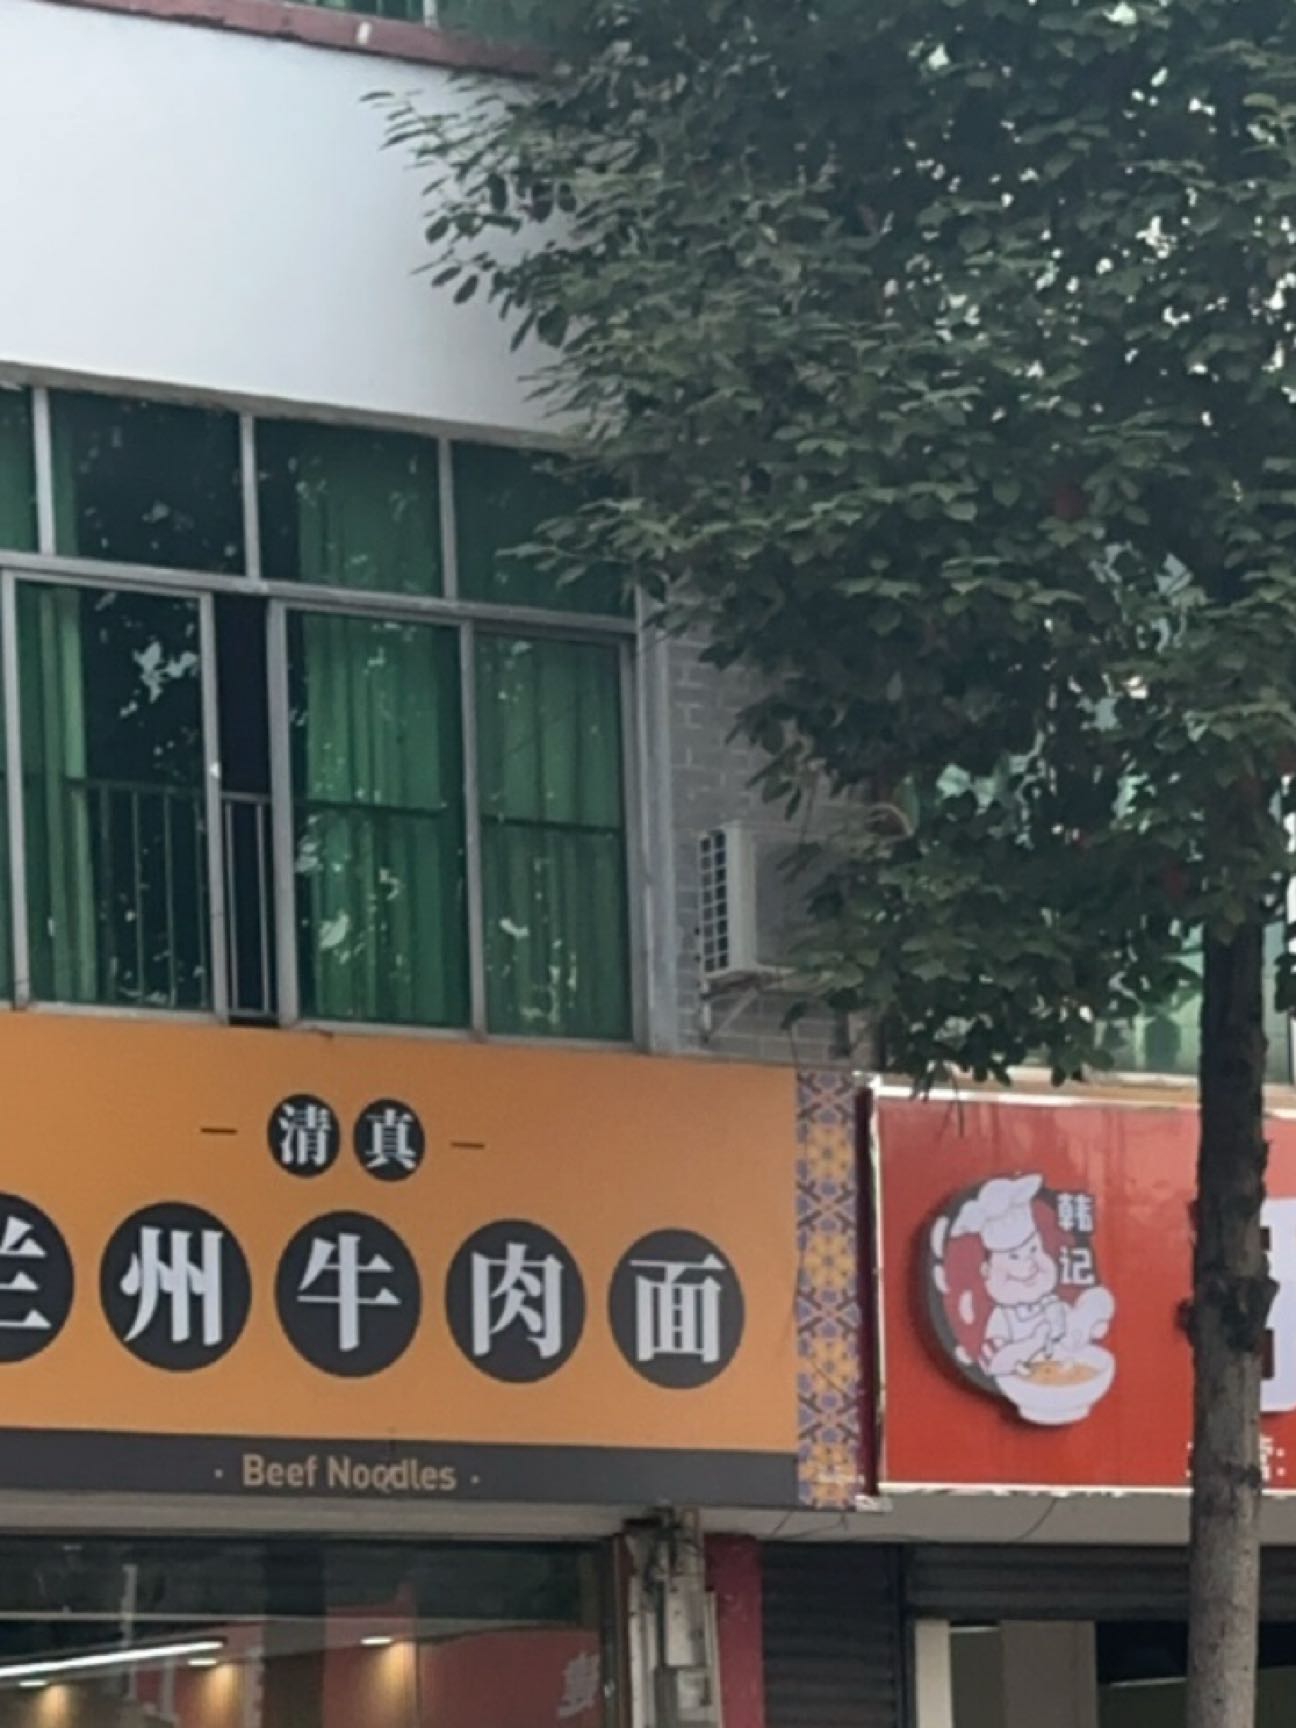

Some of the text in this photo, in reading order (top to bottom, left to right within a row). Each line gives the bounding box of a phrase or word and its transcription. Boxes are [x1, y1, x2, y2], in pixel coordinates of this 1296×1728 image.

[279, 1103, 417, 1170] 清真
[242, 1453, 457, 1492] Beef Noodles
